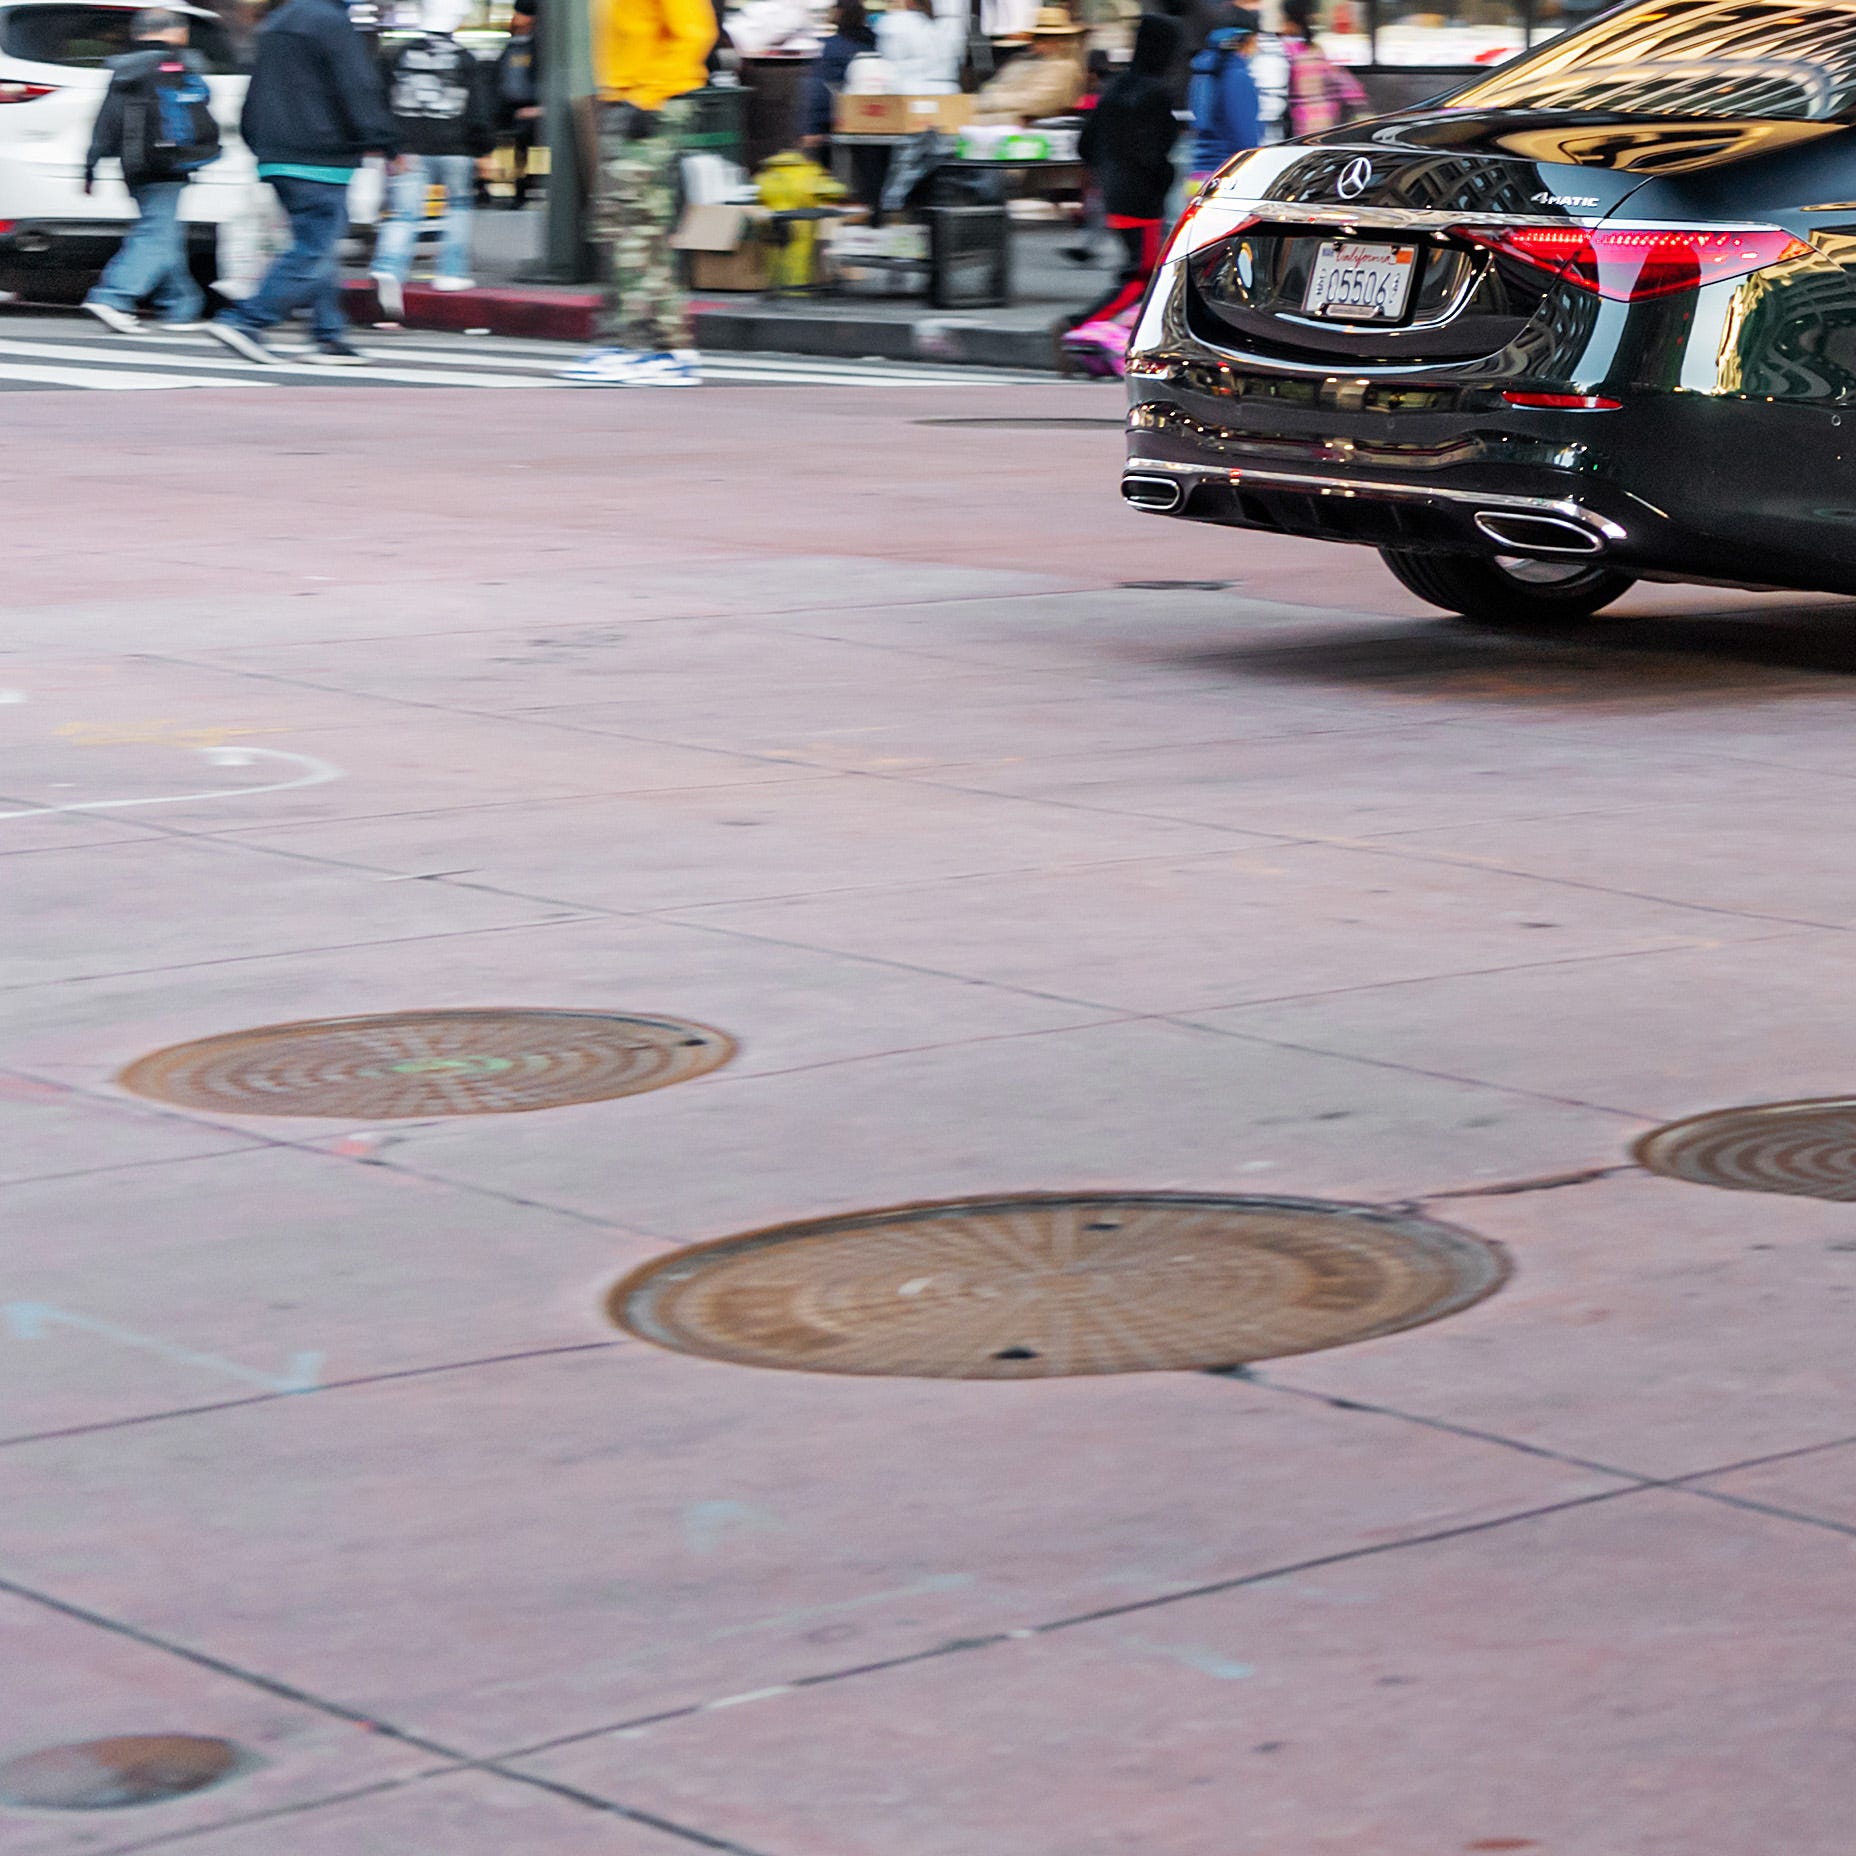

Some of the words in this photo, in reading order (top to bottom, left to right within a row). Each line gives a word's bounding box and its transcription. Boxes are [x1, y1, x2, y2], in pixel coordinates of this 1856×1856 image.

[1530, 191, 1600, 208] 4MATIC
[1336, 245, 1397, 268] California
[1326, 269, 1387, 305] 05506
